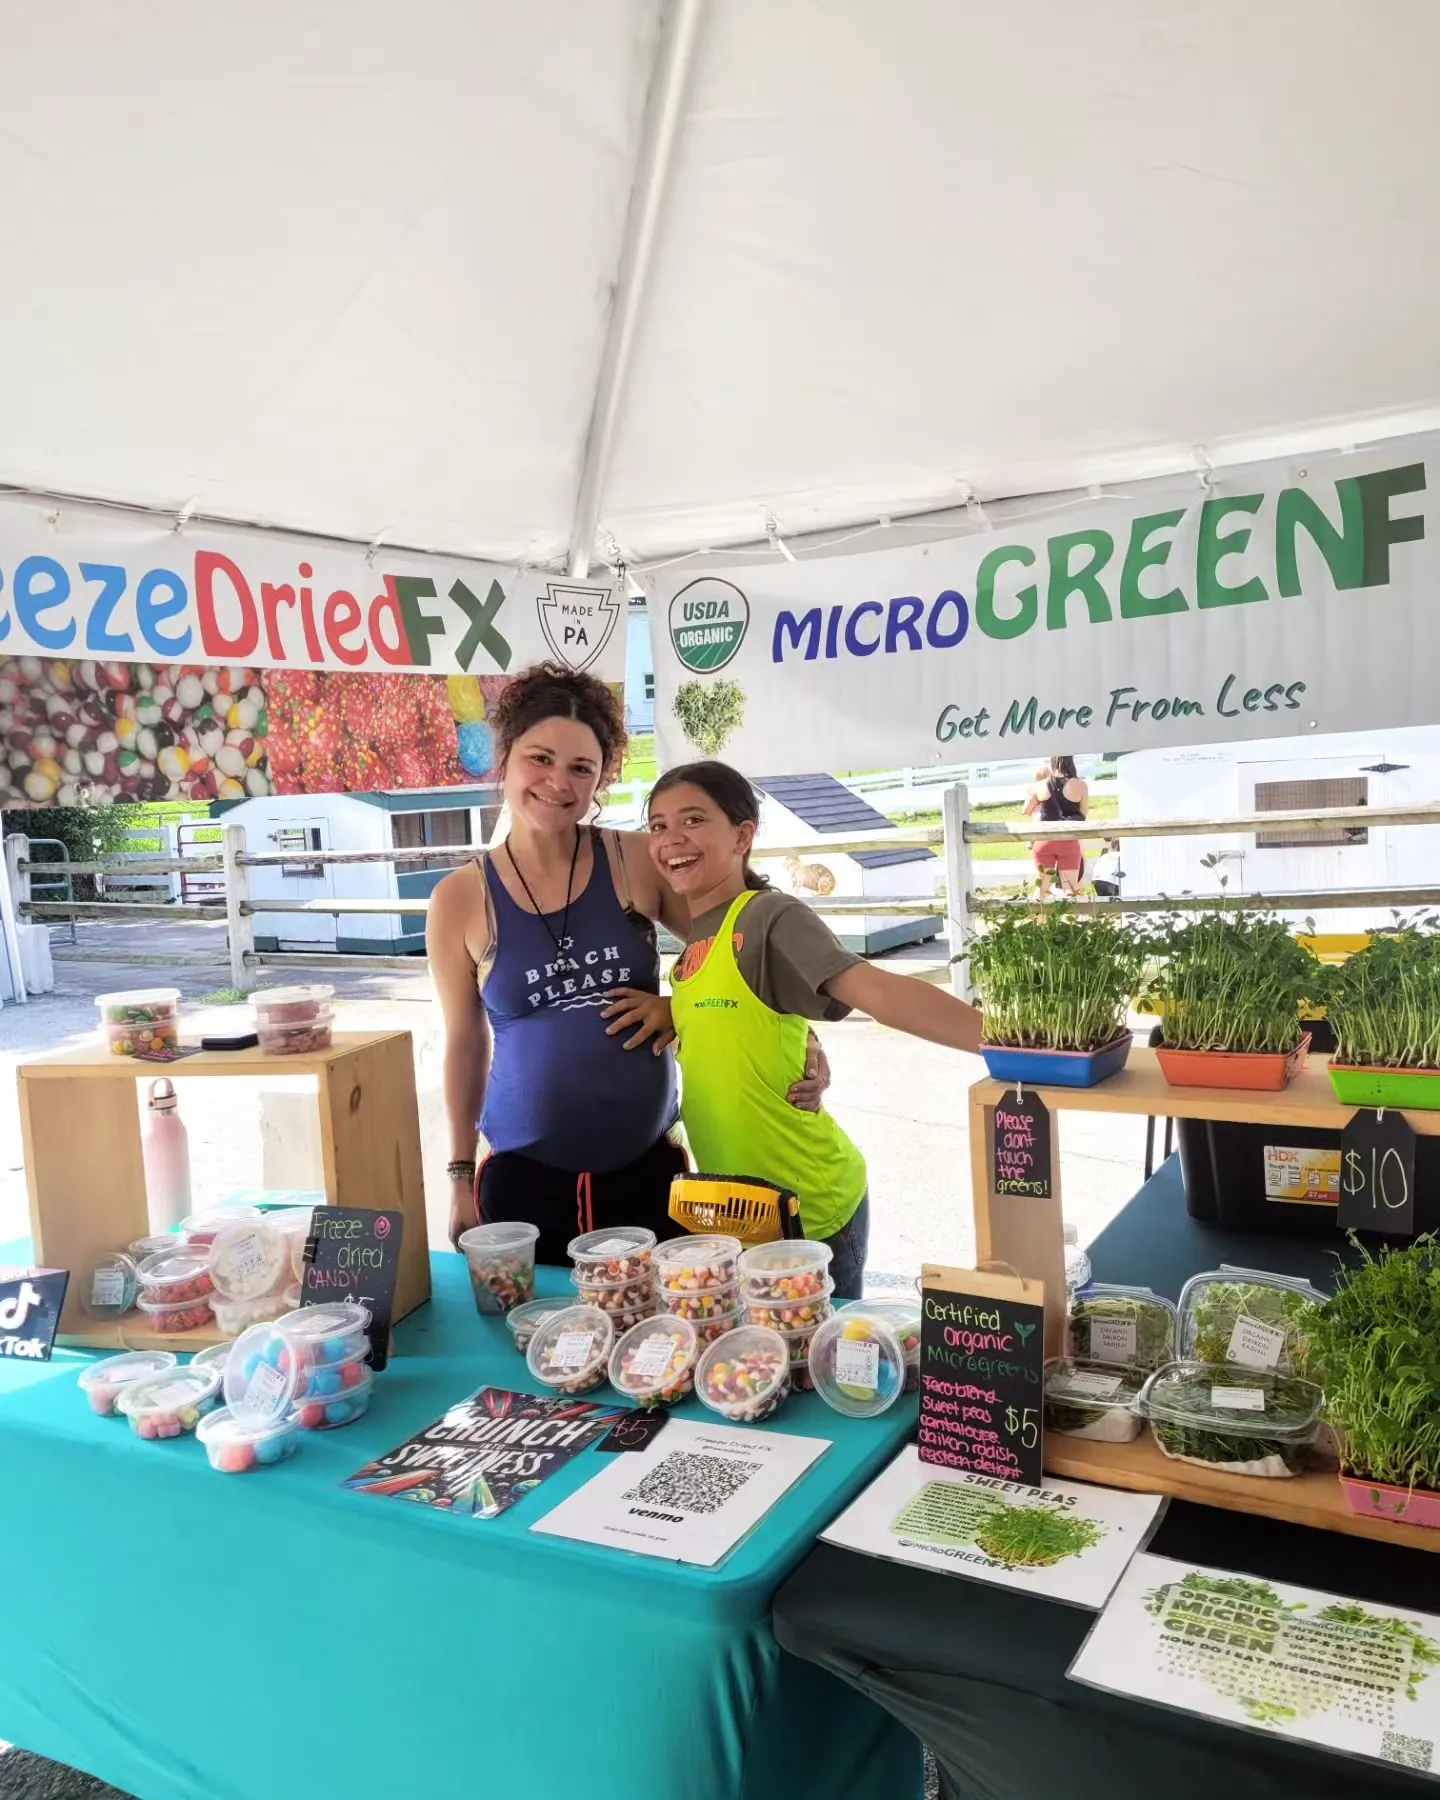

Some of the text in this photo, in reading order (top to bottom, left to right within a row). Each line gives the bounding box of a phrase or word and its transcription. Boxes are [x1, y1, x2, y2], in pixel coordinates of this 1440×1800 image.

[562, 604, 593, 617] MADE
[683, 600, 729, 622] USDA
[564, 626, 588, 645] PA
[679, 627, 734, 648] ORGANIC
[936, 673, 1307, 743] Get More From Less
[528, 967, 631, 1008] PLEASE
[996, 1110, 1035, 1131] Please
[998, 1147, 1034, 1166] touch
[1267, 1150, 1300, 1162] HDX
[997, 1164, 1026, 1181] the
[1343, 1148, 1408, 1208] $10
[313, 1211, 363, 1240] Freeze
[337, 1242, 384, 1268] dried
[307, 1266, 361, 1292] CANDY
[925, 1298, 1001, 1331] Certified
[944, 1326, 1014, 1355] Organic
[927, 1345, 1040, 1384] Microgreens
[962, 1405, 993, 1424] peas
[1004, 1405, 1039, 1449] $5
[424, 1416, 597, 1447] CRUNCH
[613, 1418, 656, 1446] $5
[383, 1443, 555, 1477] SWEETNESS
[919, 1428, 1018, 1466] daikon radish
[963, 1474, 1079, 1506] SWEET PEAS
[628, 1508, 684, 1523] venmo
[913, 1542, 1016, 1572] MICROGREENFX
[1171, 1599, 1281, 1633] MICRO
[1179, 1590, 1275, 1619] ORGANIC
[1163, 1618, 1275, 1654] GREEN
[1288, 1624, 1402, 1654] NUTRIENT-DENSE
[1159, 1633, 1195, 1648] HOW
[1199, 1642, 1222, 1654] DO
[1234, 1651, 1265, 1665] EAT
[1268, 1659, 1396, 1695] MICROGREENS?
[1326, 1660, 1401, 1682] NUTRITION
[1361, 1657, 1401, 1674] TIMES
